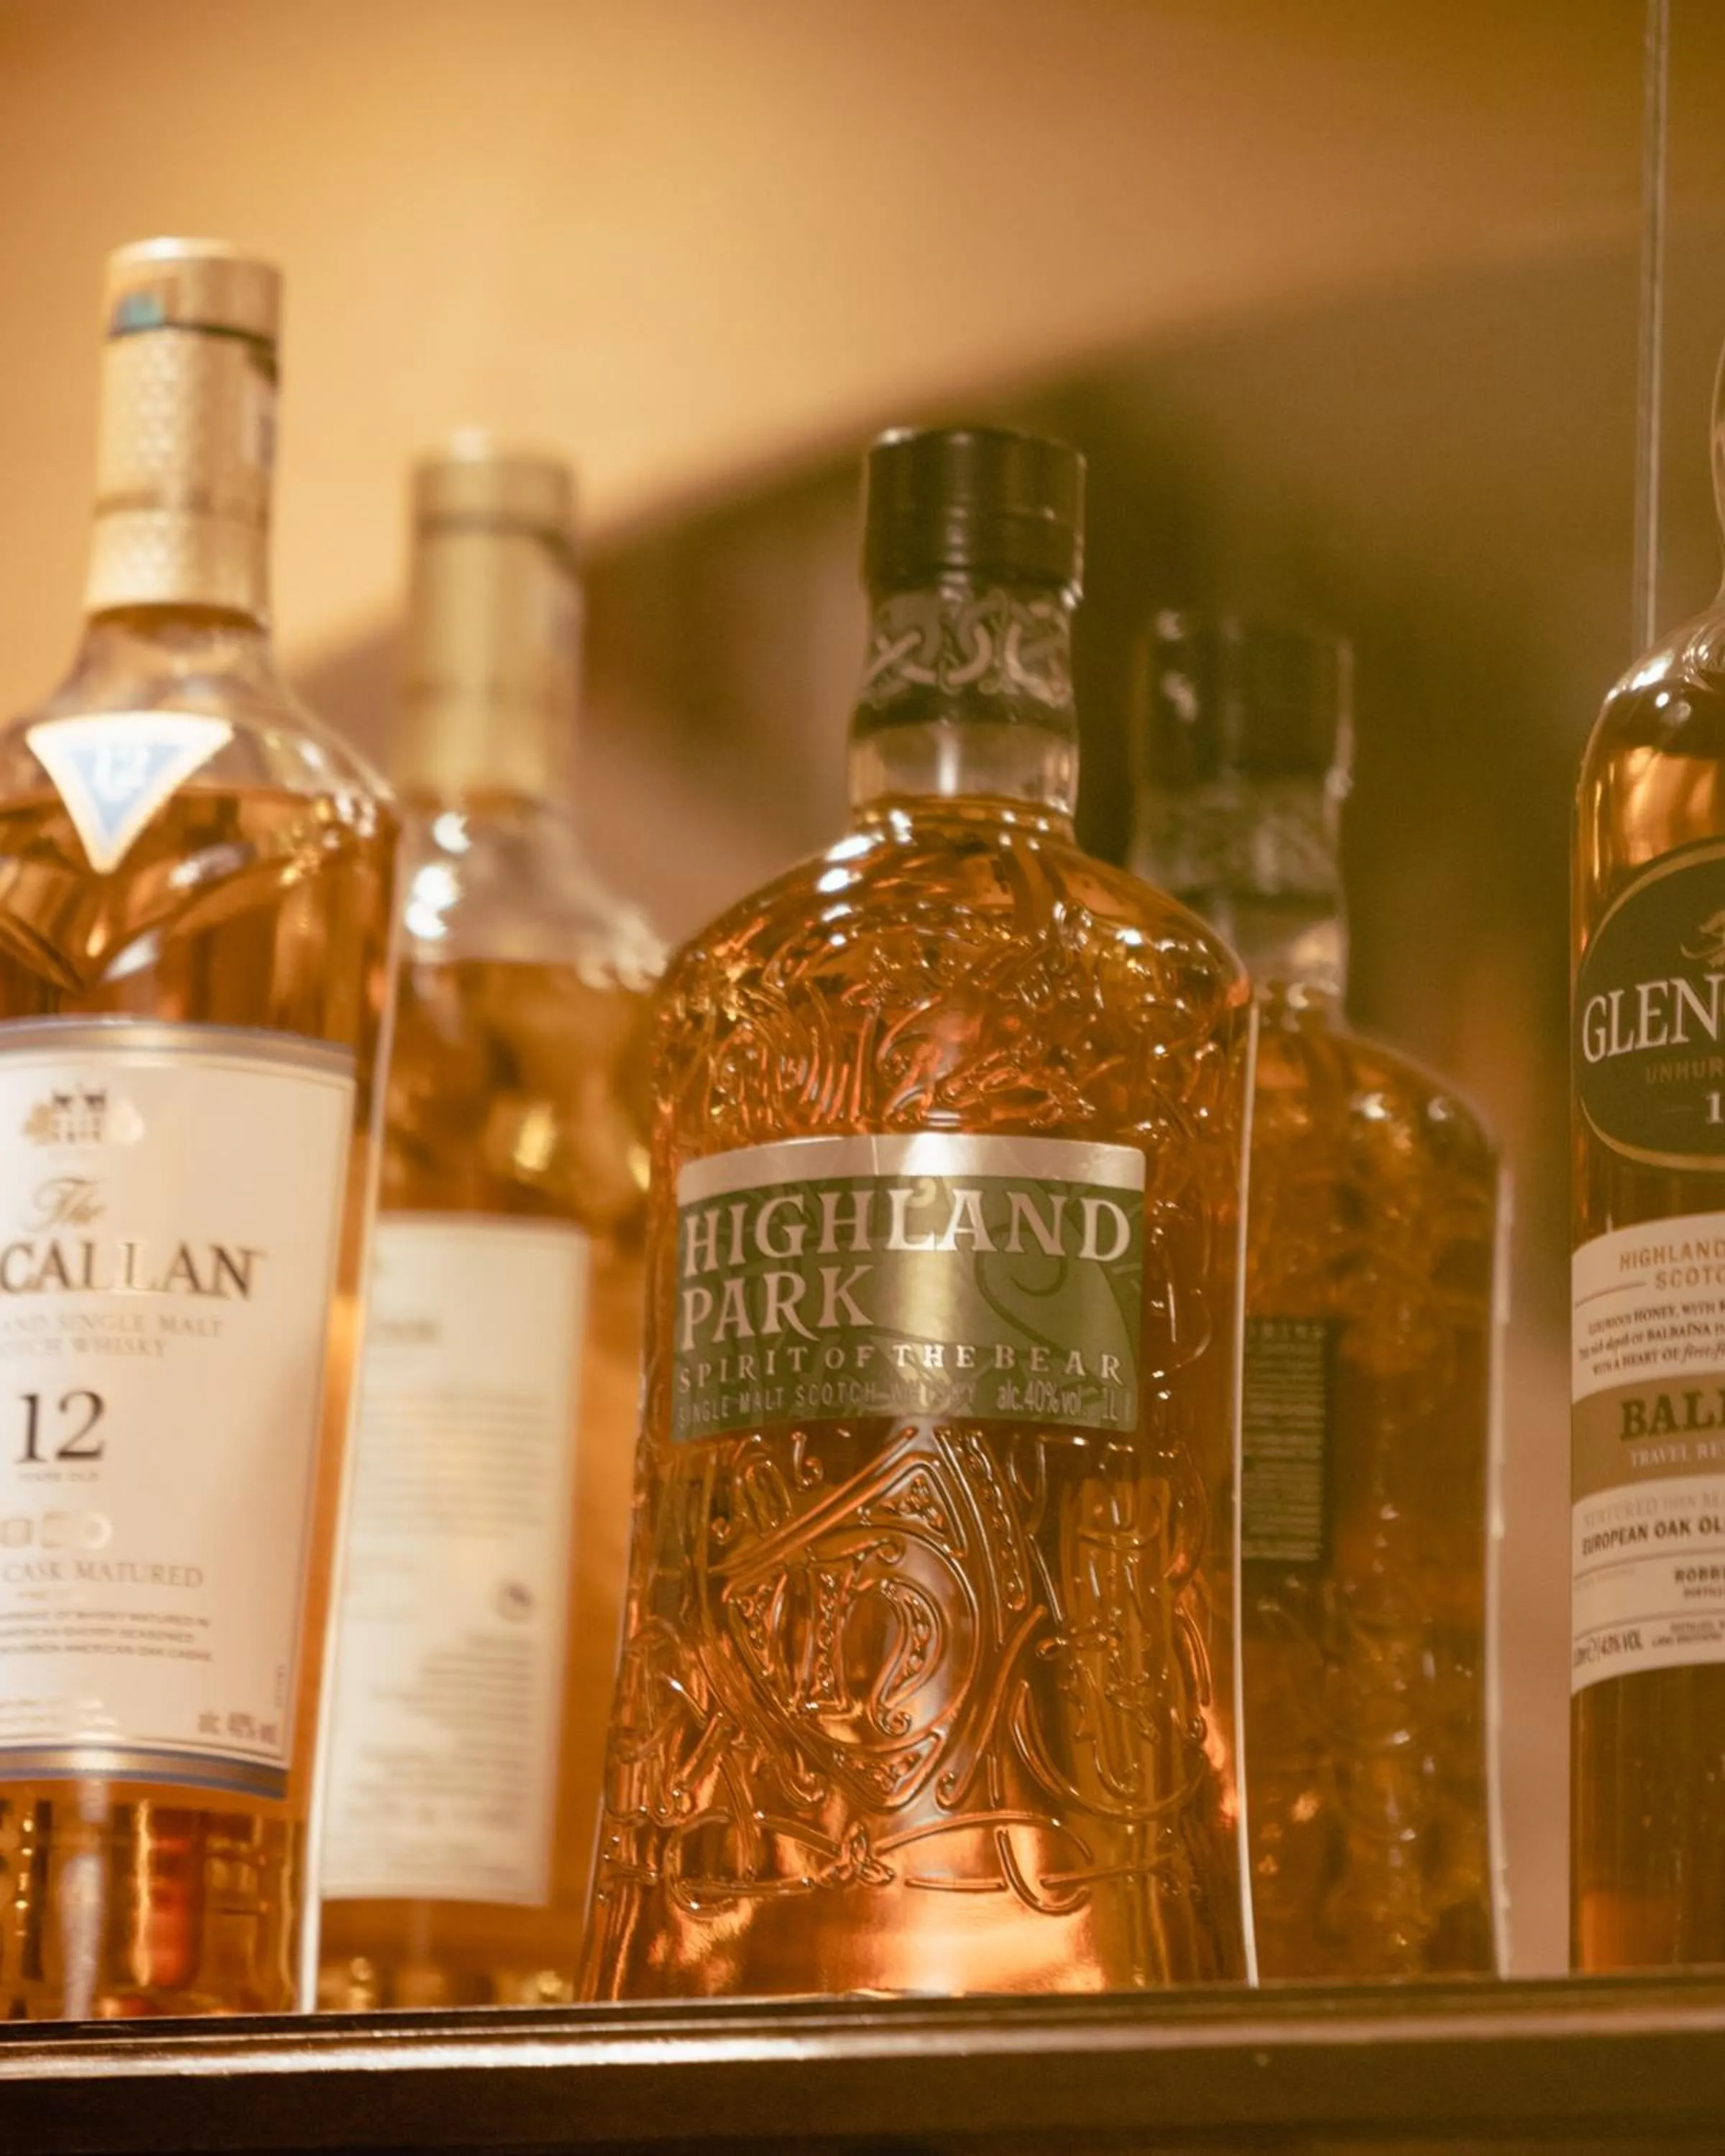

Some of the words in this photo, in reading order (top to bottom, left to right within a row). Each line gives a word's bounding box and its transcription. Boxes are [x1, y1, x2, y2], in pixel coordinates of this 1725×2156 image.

[1583, 973, 1725, 1064] GLEN
[684, 1187, 1132, 1278] HIGHLAND
[682, 1263, 875, 1351] PARK
[679, 1345, 809, 1393] SPIRIT
[825, 1345, 875, 1369] OF
[893, 1344, 976, 1369] THE
[995, 1344, 1124, 1386] BEAR
[12, 1389, 107, 1465] 12
[678, 1396, 730, 1429] SINGLE
[739, 1387, 784, 1414] MALT
[795, 1381, 875, 1408] SCOTCH
[1620, 1387, 1725, 1442] BAL
[1583, 1522, 1648, 1557] EUROPEAN
[1654, 1518, 1691, 1540] OAK
[1698, 1514, 1725, 1537] OL
[74, 1560, 204, 1588] MATURED
